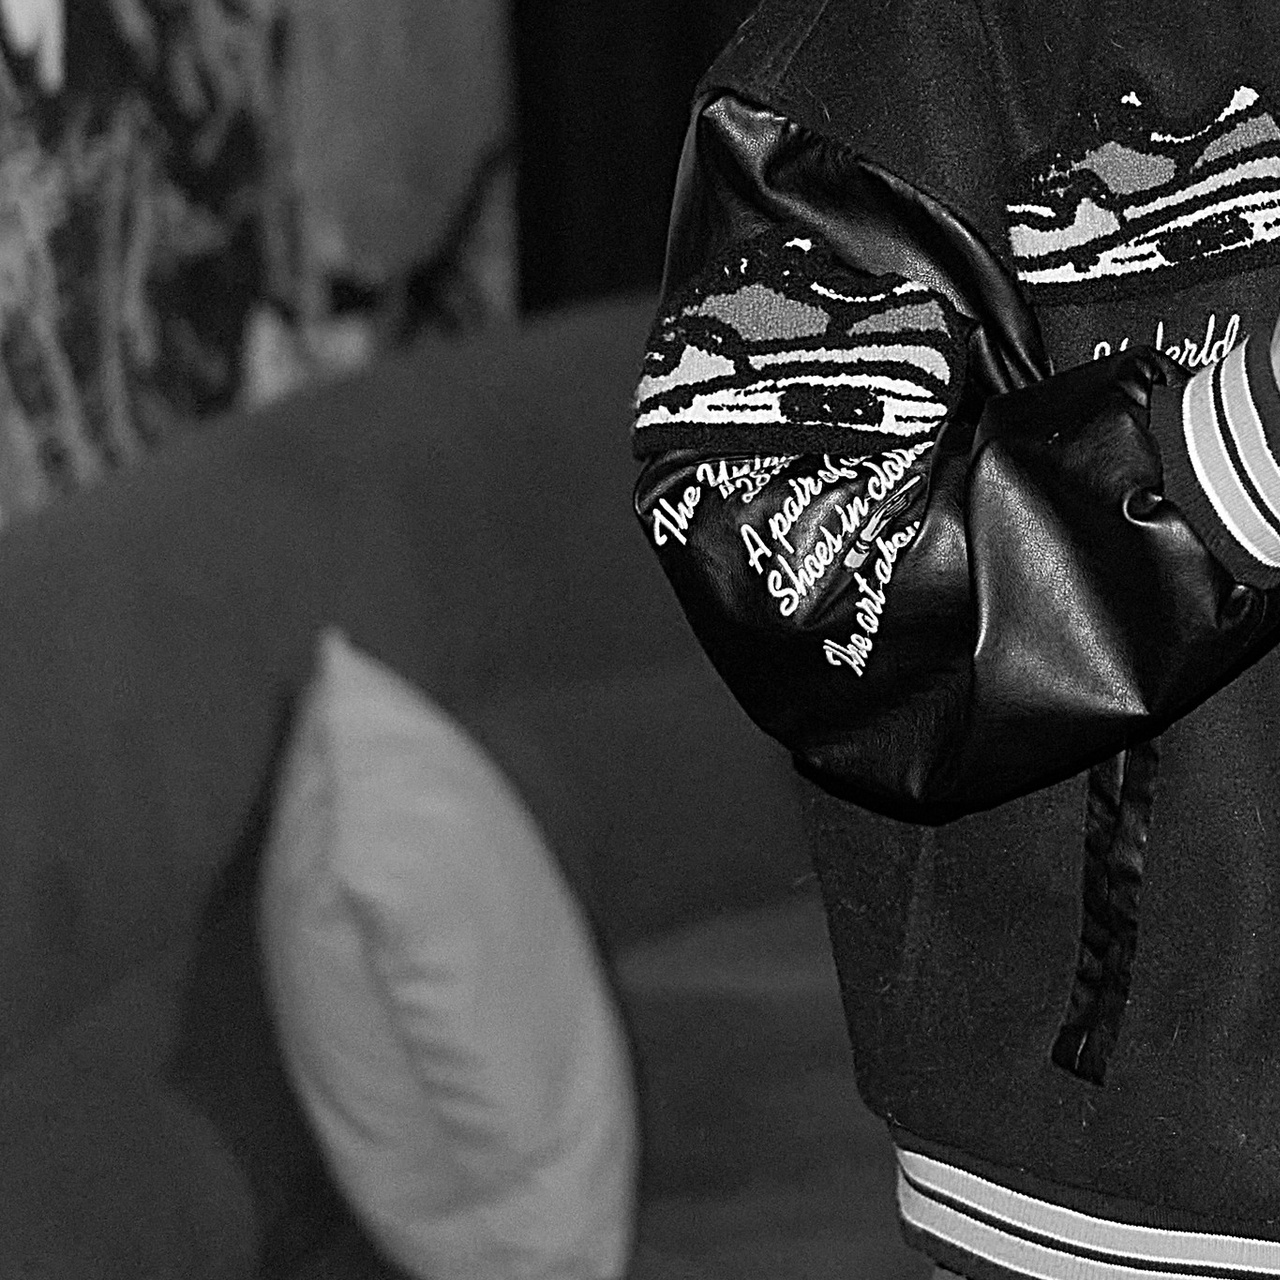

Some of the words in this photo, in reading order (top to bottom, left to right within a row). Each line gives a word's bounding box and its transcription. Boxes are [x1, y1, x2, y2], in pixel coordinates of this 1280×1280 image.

[652, 486, 701, 545] The
[741, 524, 772, 574] A
[769, 477, 823, 554] pair
[767, 526, 843, 616] Shoes
[835, 496, 870, 533] in
[823, 633, 873, 677] The
[855, 572, 886, 634] art
